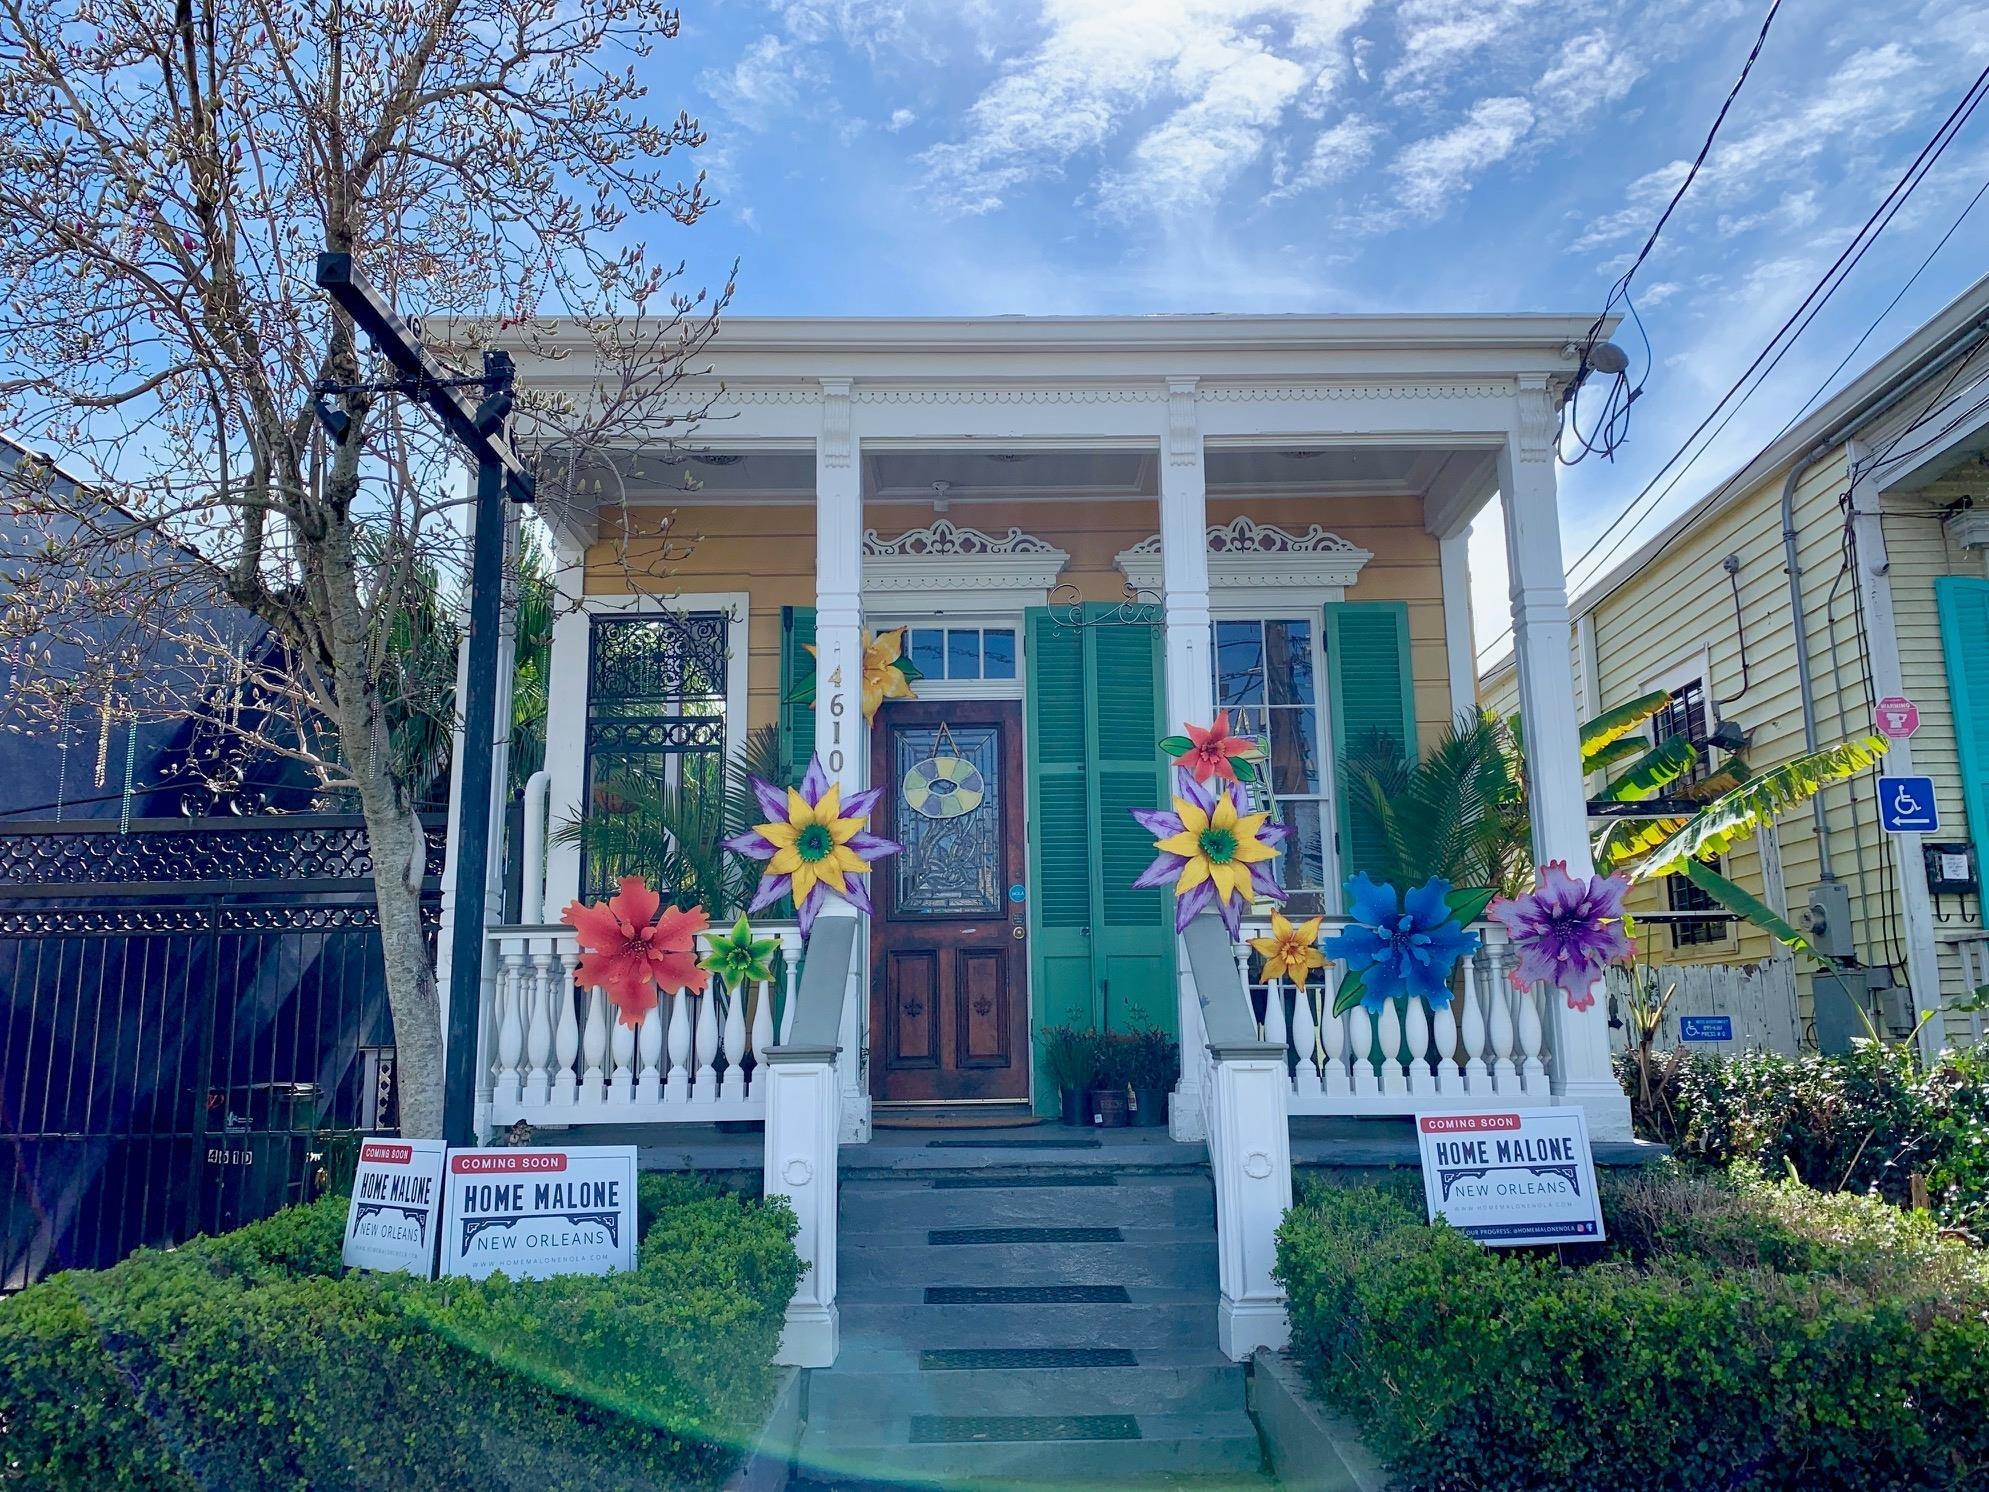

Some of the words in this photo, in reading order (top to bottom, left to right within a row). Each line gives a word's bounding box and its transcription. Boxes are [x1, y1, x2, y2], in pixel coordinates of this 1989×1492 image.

[1428, 1119, 1476, 1129] COMING
[1480, 1117, 1514, 1127] SOON
[365, 1148, 390, 1159] COMING
[391, 1148, 409, 1160] SOON
[1436, 1140, 1490, 1166] HOME
[1496, 1137, 1575, 1163] MALONE
[461, 1158, 516, 1169] COMING
[522, 1157, 559, 1168] SOON
[360, 1172, 390, 1201] HOME
[390, 1174, 432, 1205] MALONE
[464, 1184, 524, 1213] HOME
[534, 1181, 619, 1210] MALONE
[1455, 1185, 1489, 1197] NEW
[1496, 1181, 1567, 1196] ORLEANS
[359, 1223, 379, 1236] NEW
[381, 1224, 419, 1242] ORLEANS
[477, 1235, 518, 1251] NEW
[526, 1231, 605, 1248] ORLEANS
